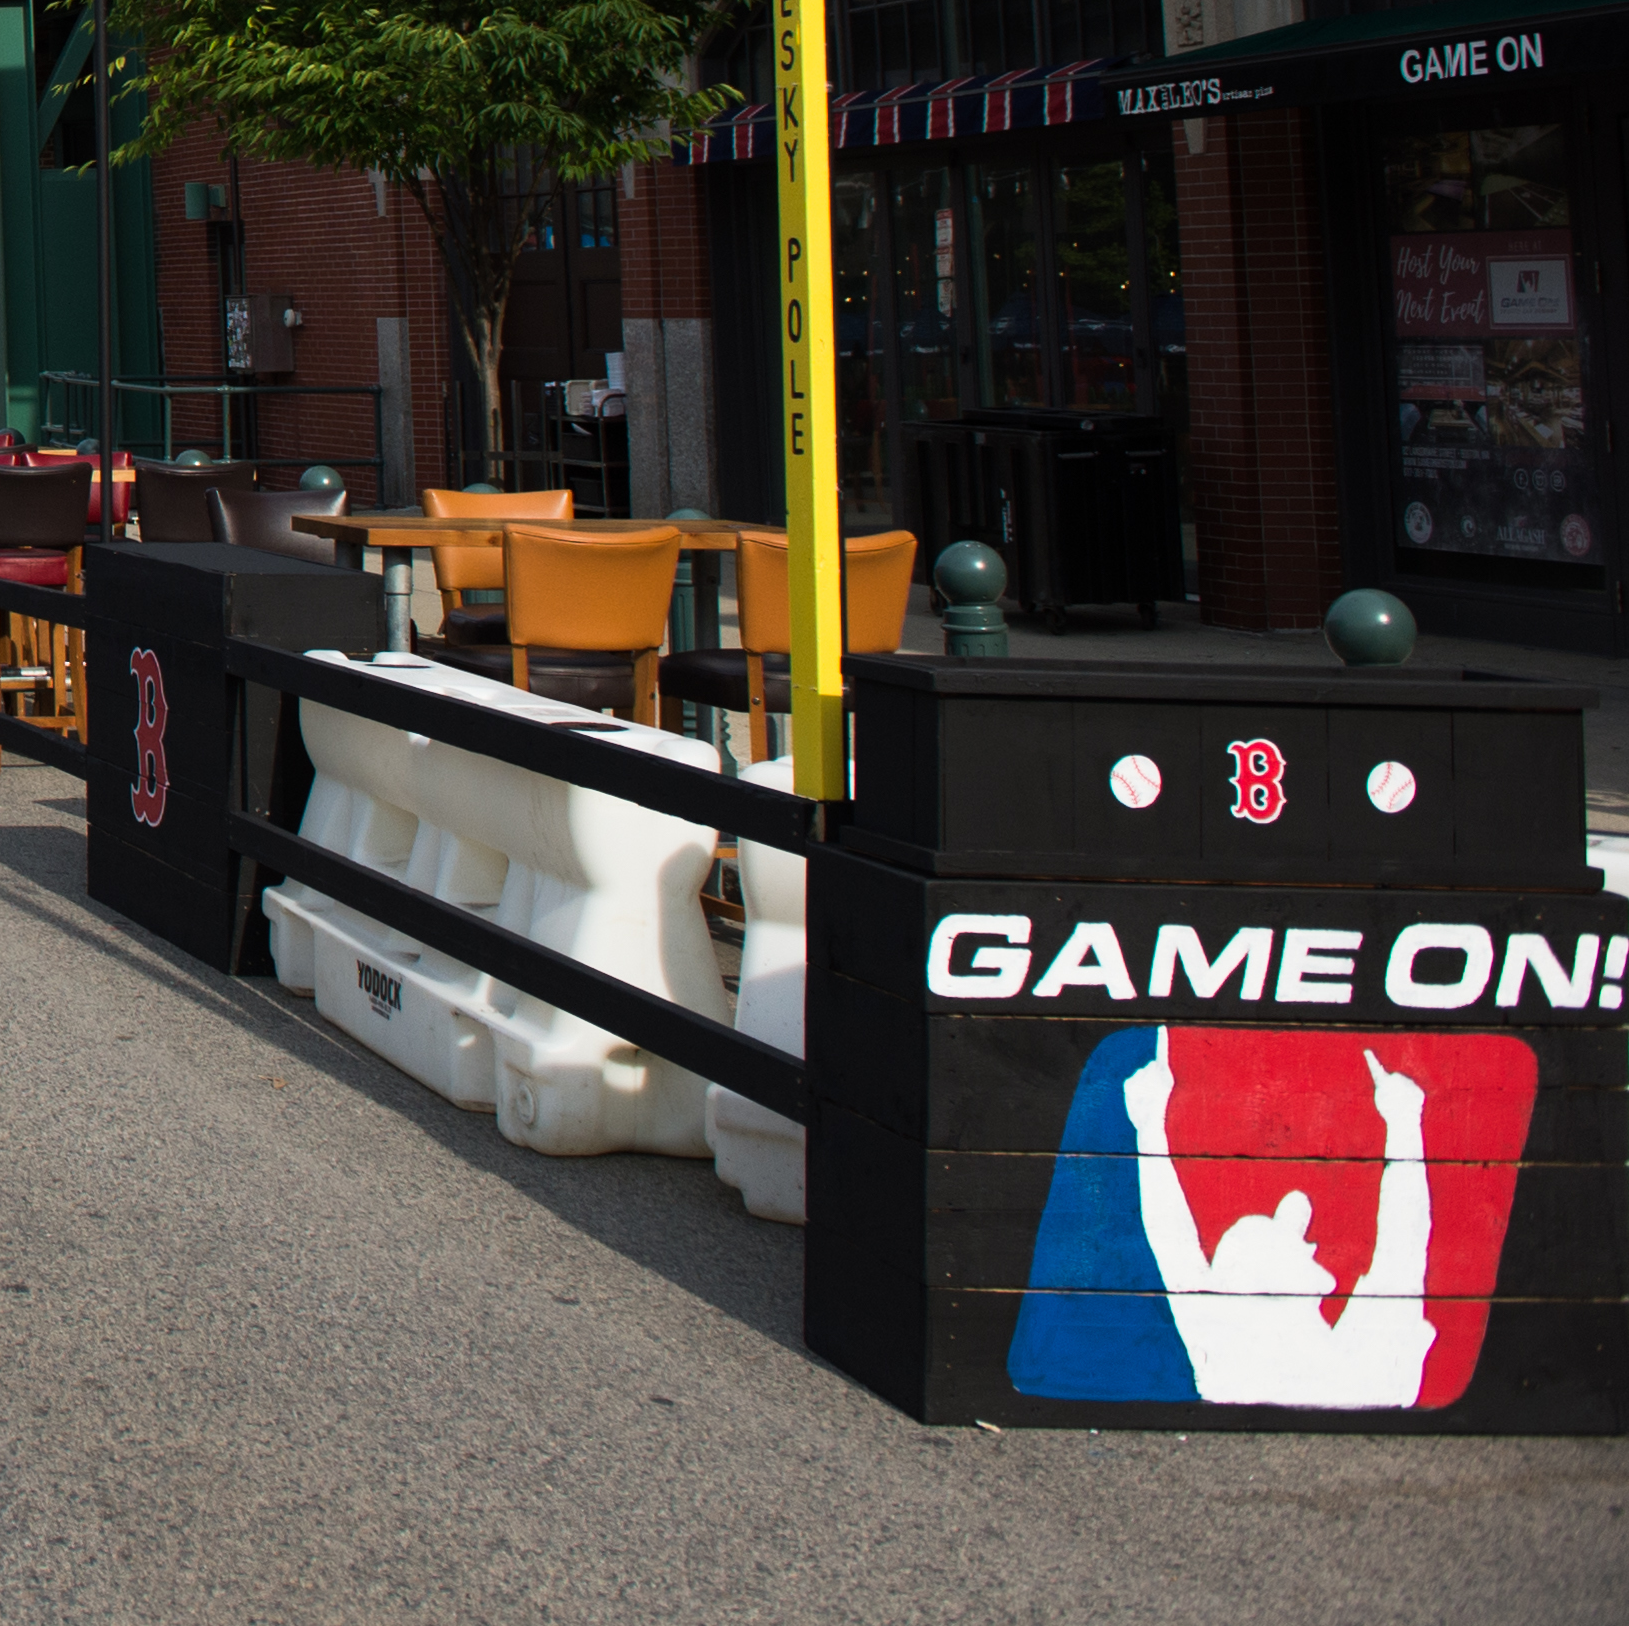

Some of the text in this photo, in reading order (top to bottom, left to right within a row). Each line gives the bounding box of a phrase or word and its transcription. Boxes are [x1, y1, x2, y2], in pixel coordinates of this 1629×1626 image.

[1400, 33, 1544, 83] GAME ON
[1117, 88, 1161, 115] MAX
[1169, 78, 1221, 108] LEO'S
[1396, 243, 1481, 285] Host Your
[1396, 288, 1485, 324] Next Event
[787, 237, 805, 457] POLE
[130, 646, 170, 828] B
[1227, 738, 1287, 824] B
[356, 959, 403, 1011] YODOCK
[927, 913, 1629, 1010] GAME ON!
